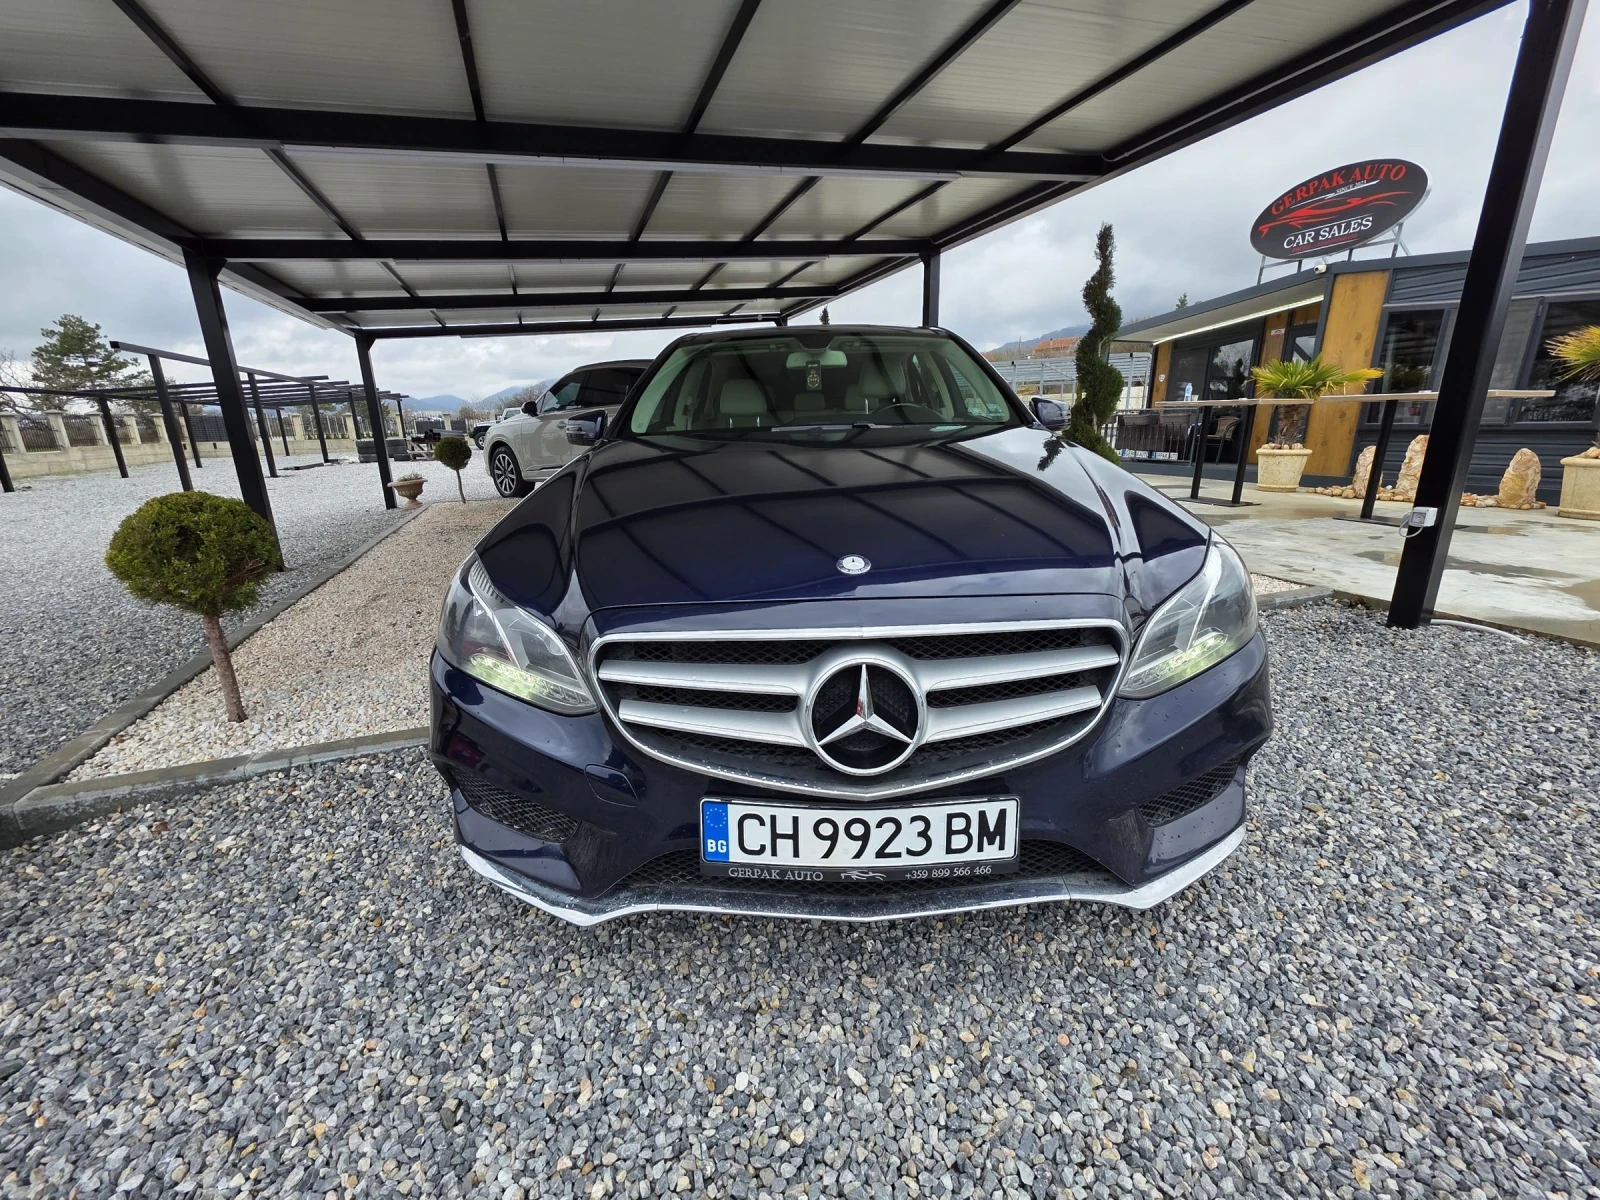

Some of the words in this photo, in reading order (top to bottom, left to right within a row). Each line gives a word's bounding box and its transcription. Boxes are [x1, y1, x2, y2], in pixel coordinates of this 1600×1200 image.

[1271, 171, 1347, 214] GERPAK
[1350, 163, 1407, 181] AUTO
[1336, 183, 1354, 195] SINCE
[1283, 231, 1316, 249] CAR
[1318, 216, 1373, 240] SALES
[737, 812, 800, 859] CH
[812, 815, 933, 860] 9923
[945, 807, 1007, 855] BM
[707, 839, 727, 853] BG
[728, 867, 781, 879] GERPAK
[784, 871, 824, 882] AUTO
[905, 870, 928, 880] +359
[931, 868, 949, 879] 899
[950, 867, 971, 878] 566
[974, 865, 992, 876] 466
